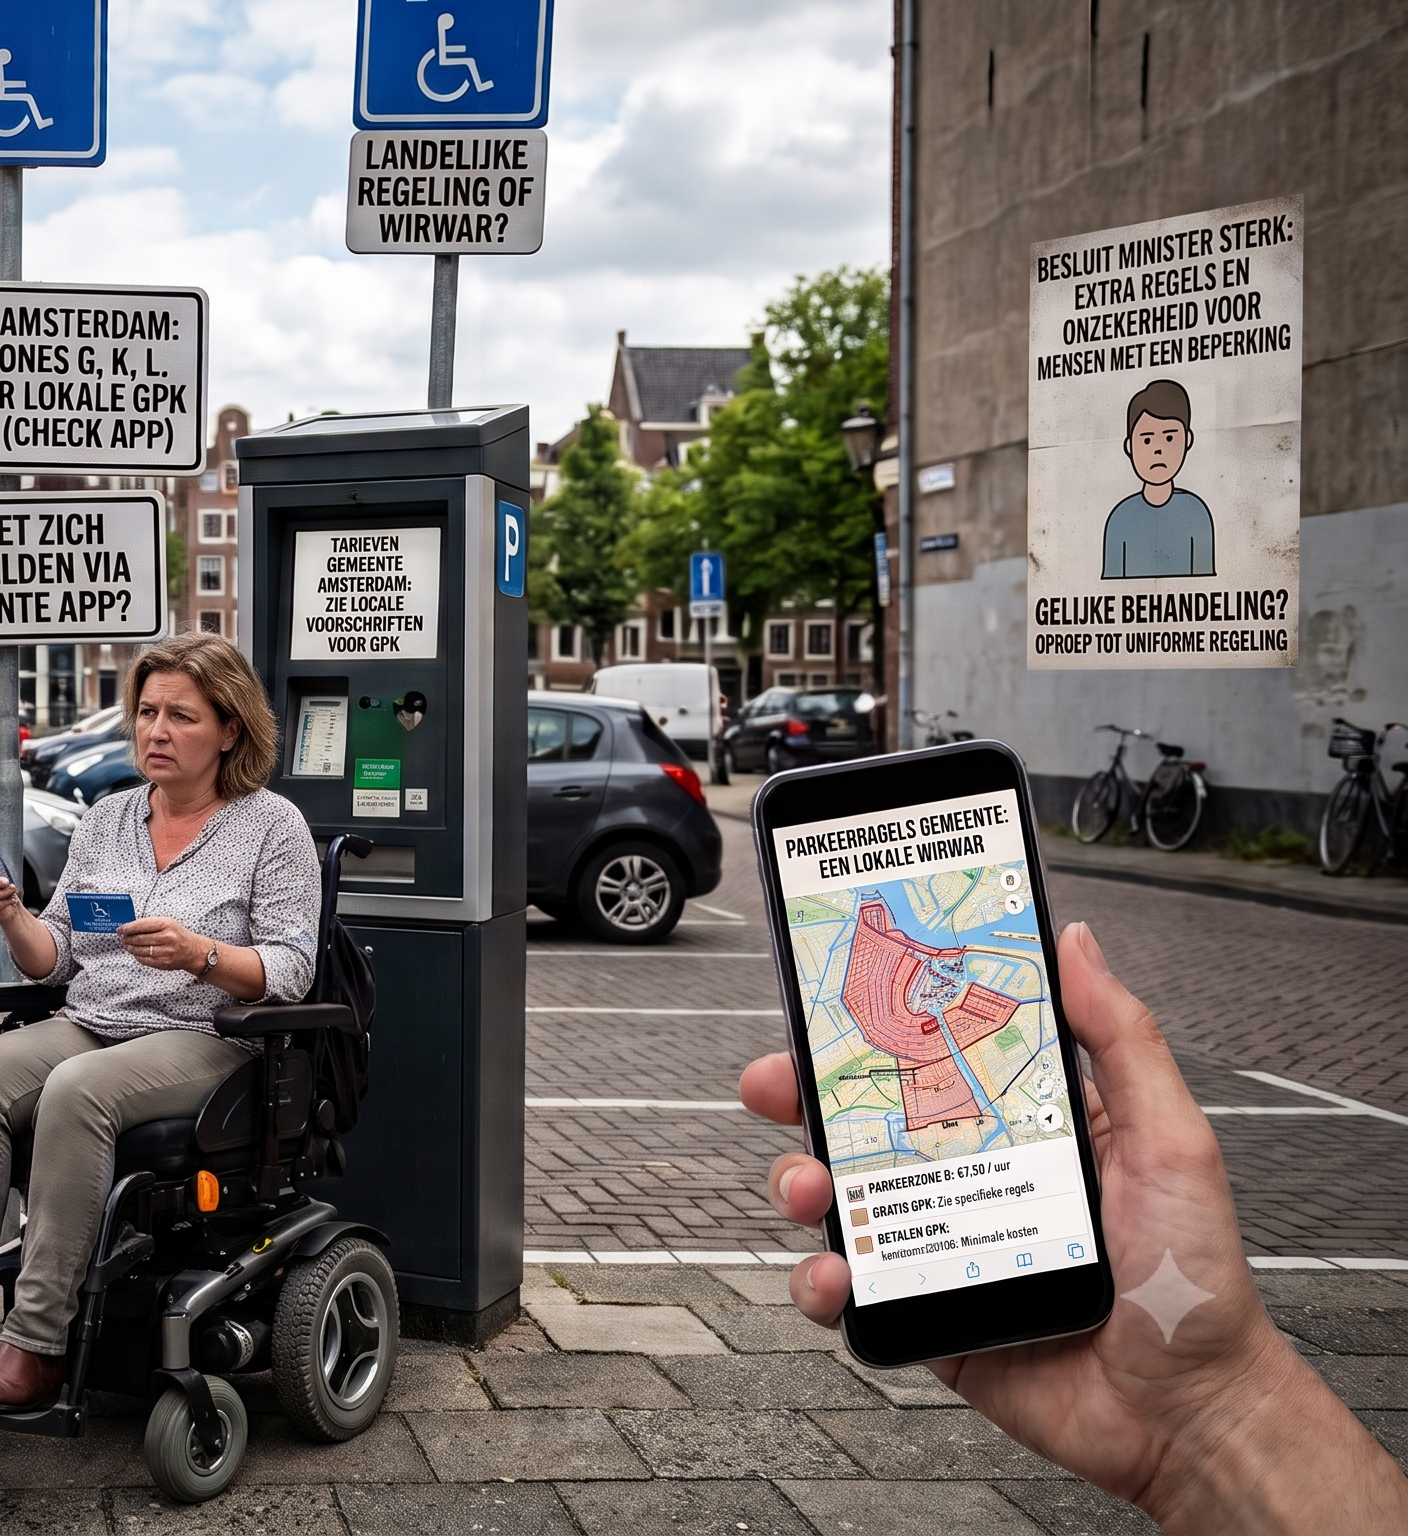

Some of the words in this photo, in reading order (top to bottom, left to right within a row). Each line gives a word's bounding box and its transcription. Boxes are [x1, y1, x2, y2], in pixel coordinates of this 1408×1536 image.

[366, 139, 528, 170] LANDELIJKE
[358, 176, 490, 207] REGELING
[498, 176, 534, 207] OF
[379, 212, 508, 243] WIRWAR?
[1038, 245, 1114, 283] BESLUIT
[1119, 228, 1213, 270] MINISTER
[1220, 214, 1293, 253] STERK:
[1075, 276, 1136, 310] EXTRA
[1142, 262, 1216, 300] REGELS
[1223, 256, 1250, 288] EN
[0, 306, 179, 341] AMSTERDAM:
[1063, 301, 1198, 345] ONZEKERHEID
[1204, 291, 1261, 326] VOOR
[78, 346, 103, 380] G,
[112, 347, 137, 382] K,
[146, 348, 168, 378] L.
[1038, 348, 1105, 381] MENSEN
[1110, 343, 1146, 371] MET
[1150, 338, 1183, 367] EEN
[1188, 324, 1291, 362] BEPERKING
[24, 381, 126, 412] LOKALE
[133, 383, 187, 414] GPK
[3, 415, 102, 452] (CHECK
[110, 417, 174, 454] APP)
[38, 513, 104, 546] ZICH
[330, 536, 399, 553] TARIEVEN
[327, 555, 403, 573] GEMEENTE
[505, 514, 519, 582] P
[82, 551, 131, 582] VIA
[317, 575, 412, 593] AMSTERDAM:
[58, 590, 131, 622] APP?
[325, 596, 347, 612] ZIE
[351, 596, 404, 612] LOCALE
[1035, 596, 1116, 626] GELIJKE
[1122, 588, 1288, 624] BEHANDELING?
[306, 615, 423, 632] VOORSCHRIFTEN
[328, 636, 366, 652] VOOR
[370, 636, 400, 652] GPK
[1035, 633, 1092, 654] OPROEP
[1095, 633, 1122, 654] TOT
[1126, 631, 1205, 653] UNIFORME
[1210, 629, 1288, 652] REGELING
[786, 819, 916, 859] PARKEERRAGELS
[920, 804, 1009, 836] GEMEENTE:
[819, 852, 851, 879] EEN
[853, 845, 915, 874] LOKALE
[916, 834, 985, 863] WIRWAR
[868, 1170, 942, 1194] PARKEERZONE
[944, 1169, 955, 1181] B:
[957, 1163, 985, 1178] €7,50
[988, 1162, 991, 1174] /
[994, 1162, 1010, 1172] uur
[872, 1202, 910, 1218] GRATIS
[911, 1198, 936, 1212] GPK:
[937, 1196, 952, 1208] Zie
[954, 1186, 1003, 1207] specifieke
[1005, 1181, 1035, 1197] regels
[877, 1226, 924, 1245] BETALEN
[925, 1222, 950, 1236] GPK:
[960, 1230, 1005, 1247] Minimale
[1006, 1226, 1038, 1240] kosten
